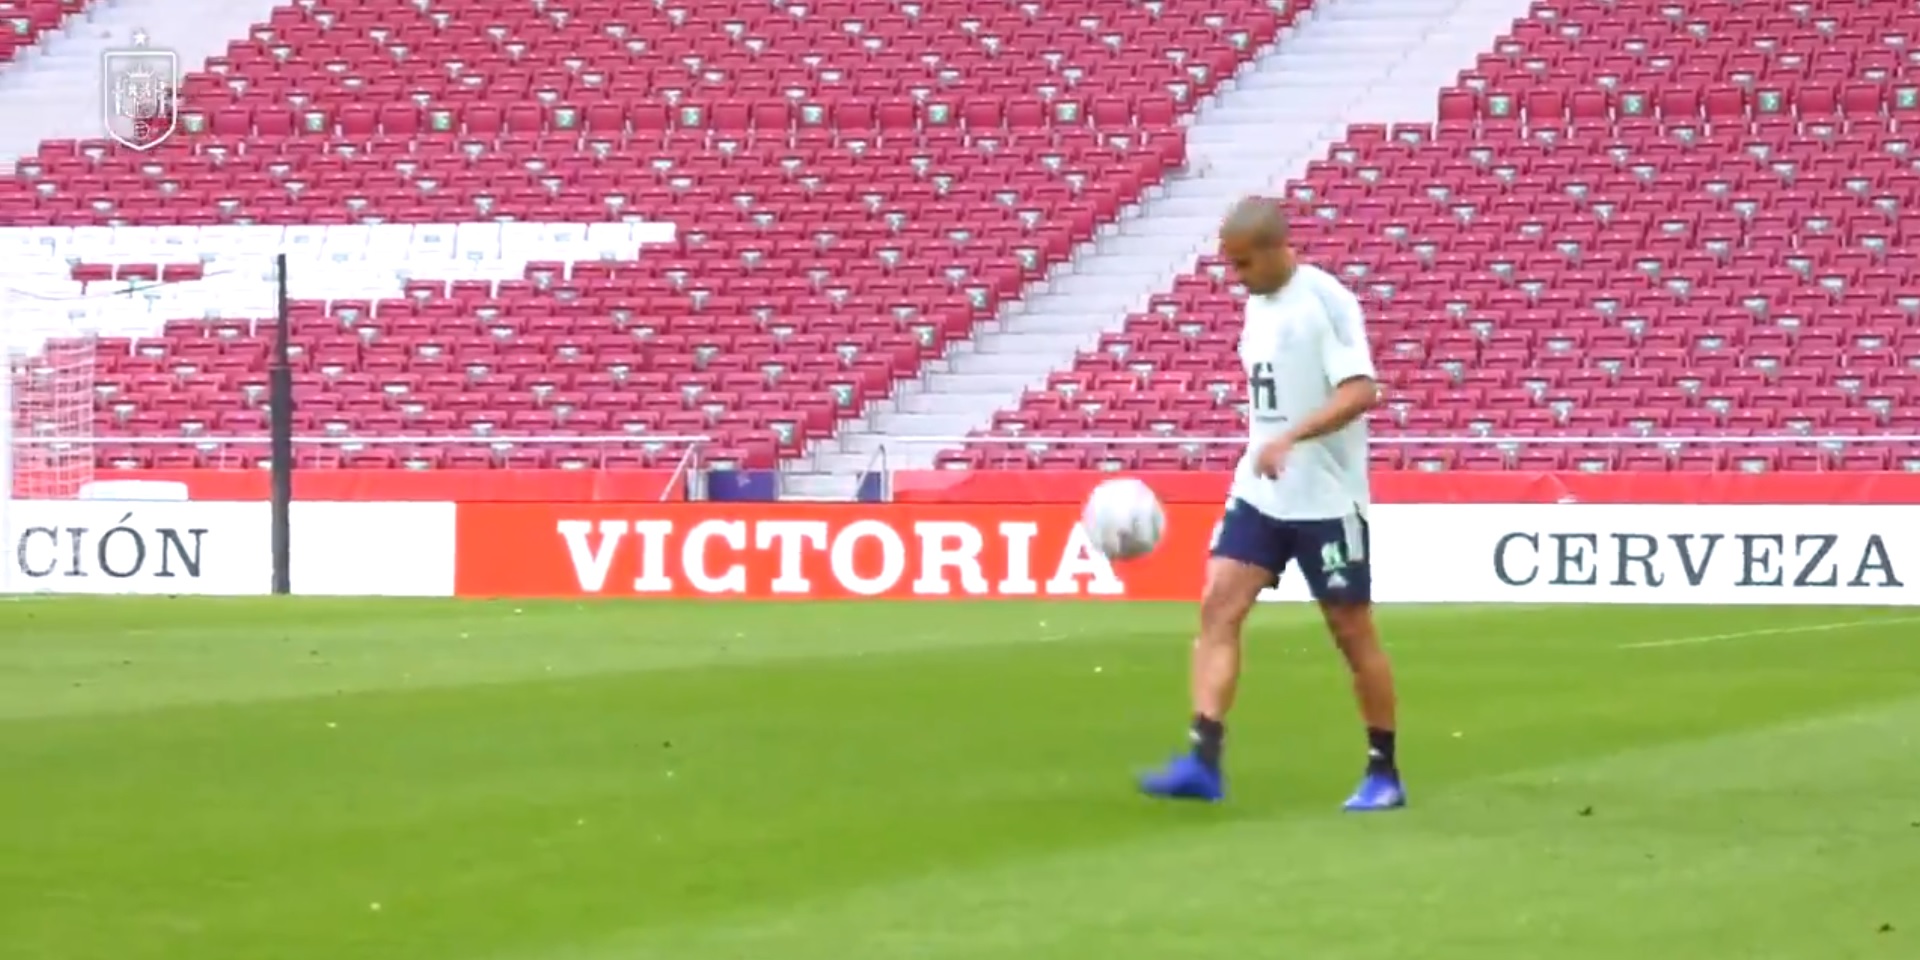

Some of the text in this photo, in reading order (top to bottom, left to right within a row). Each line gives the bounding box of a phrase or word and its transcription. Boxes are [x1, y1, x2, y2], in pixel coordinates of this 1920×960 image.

[17, 512, 208, 577] CIÓN
[557, 520, 1124, 595] VICTORIA
[1493, 532, 1904, 587] CERVEZA
